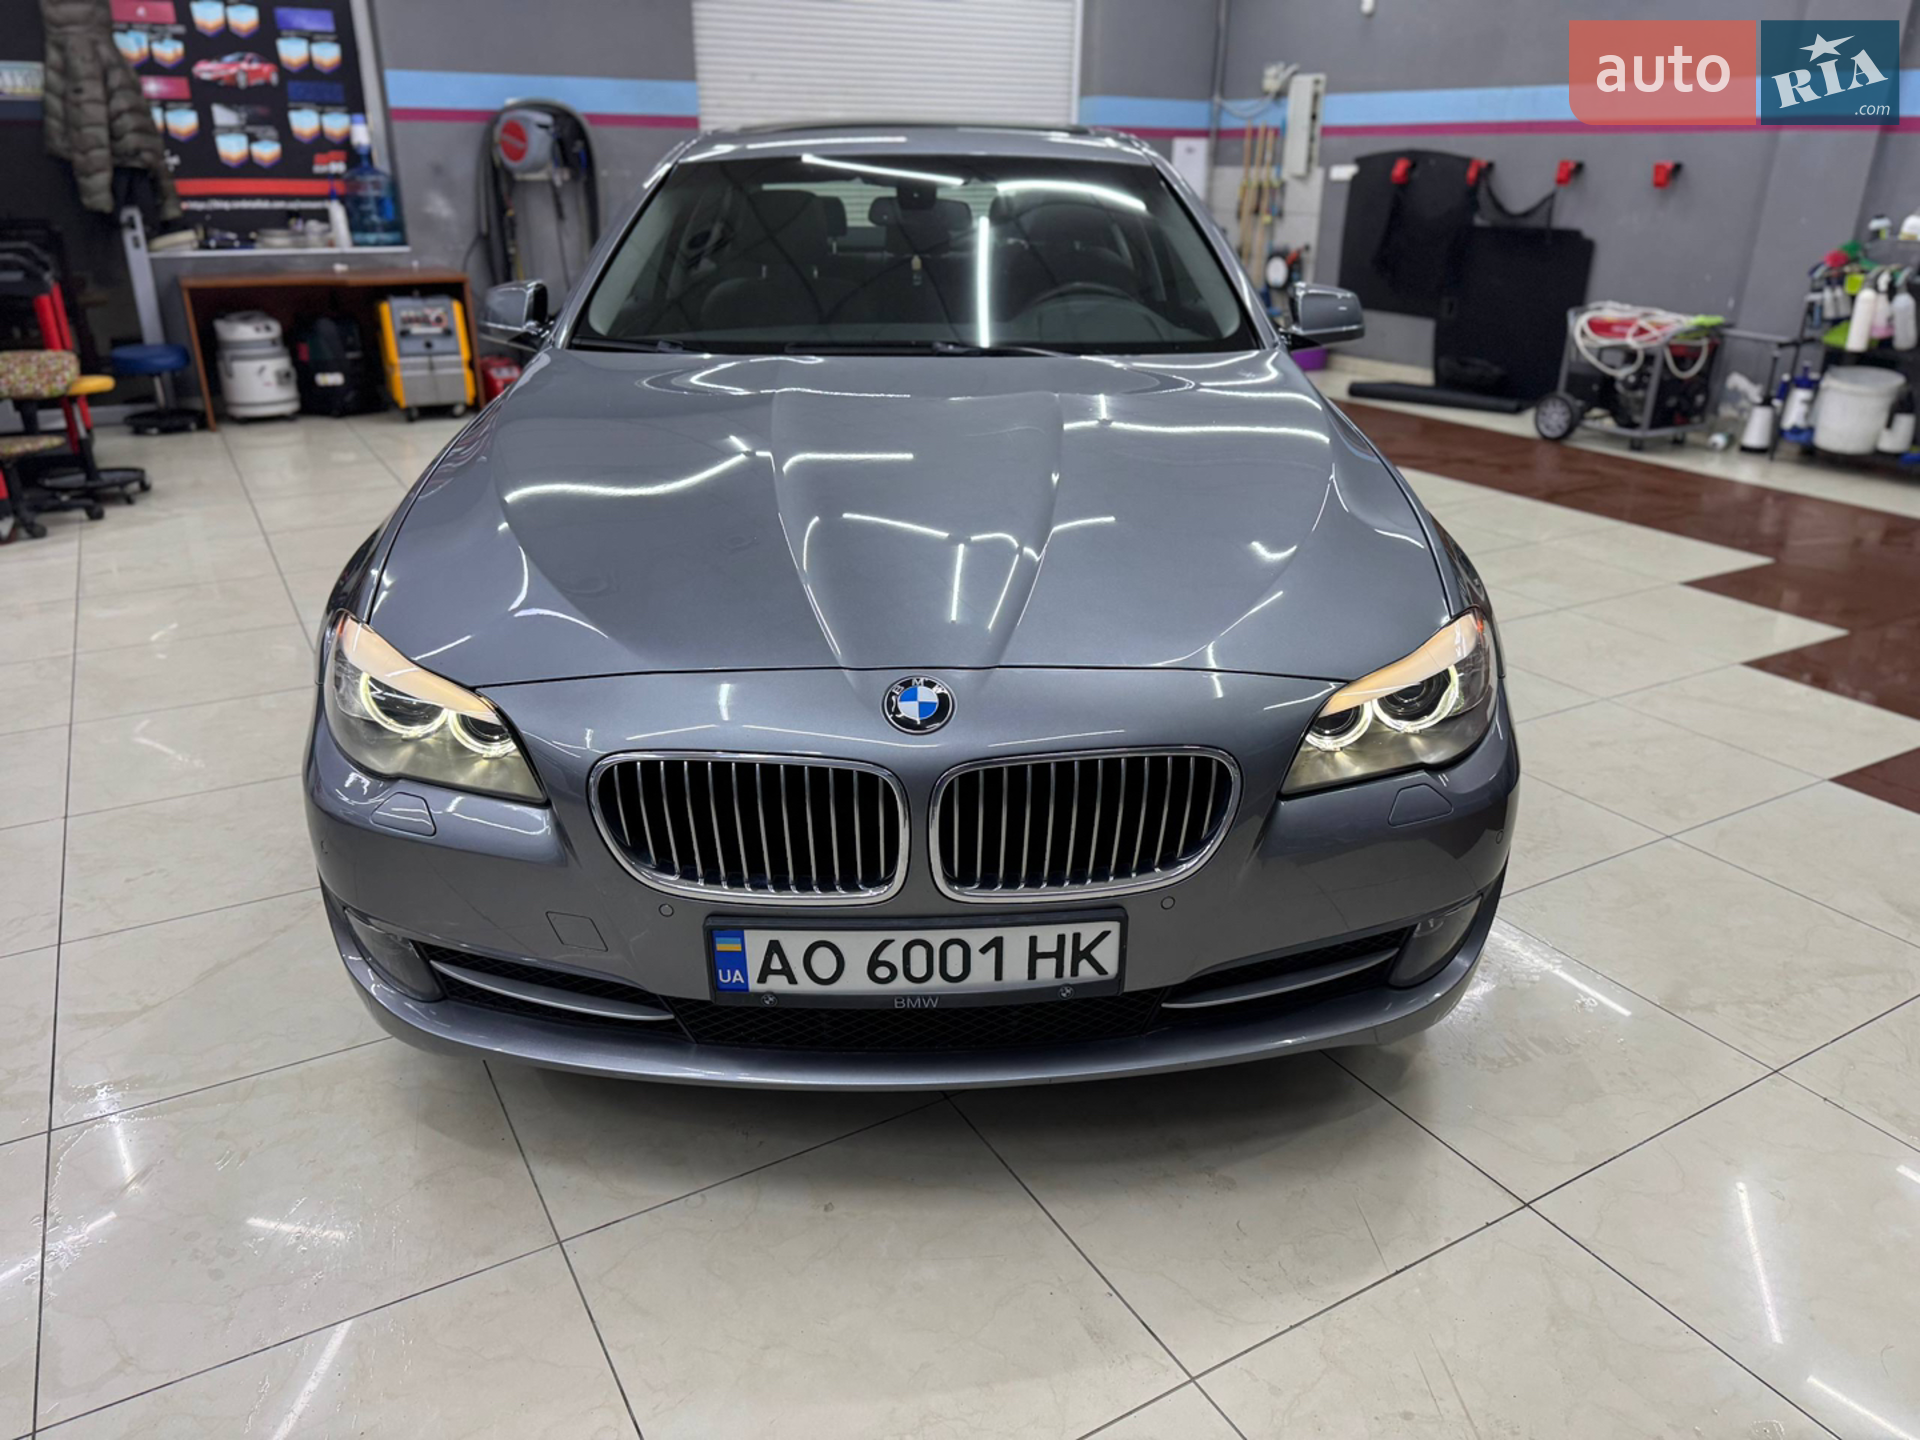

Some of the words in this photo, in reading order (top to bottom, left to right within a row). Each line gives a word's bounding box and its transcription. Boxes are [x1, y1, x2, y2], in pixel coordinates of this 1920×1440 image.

[892, 677, 949, 696] BMW
[756, 939, 845, 986] AO
[866, 935, 1005, 985] 6001
[1027, 930, 1112, 981] HK
[718, 968, 745, 984] UA
[894, 996, 939, 1009] BMW
